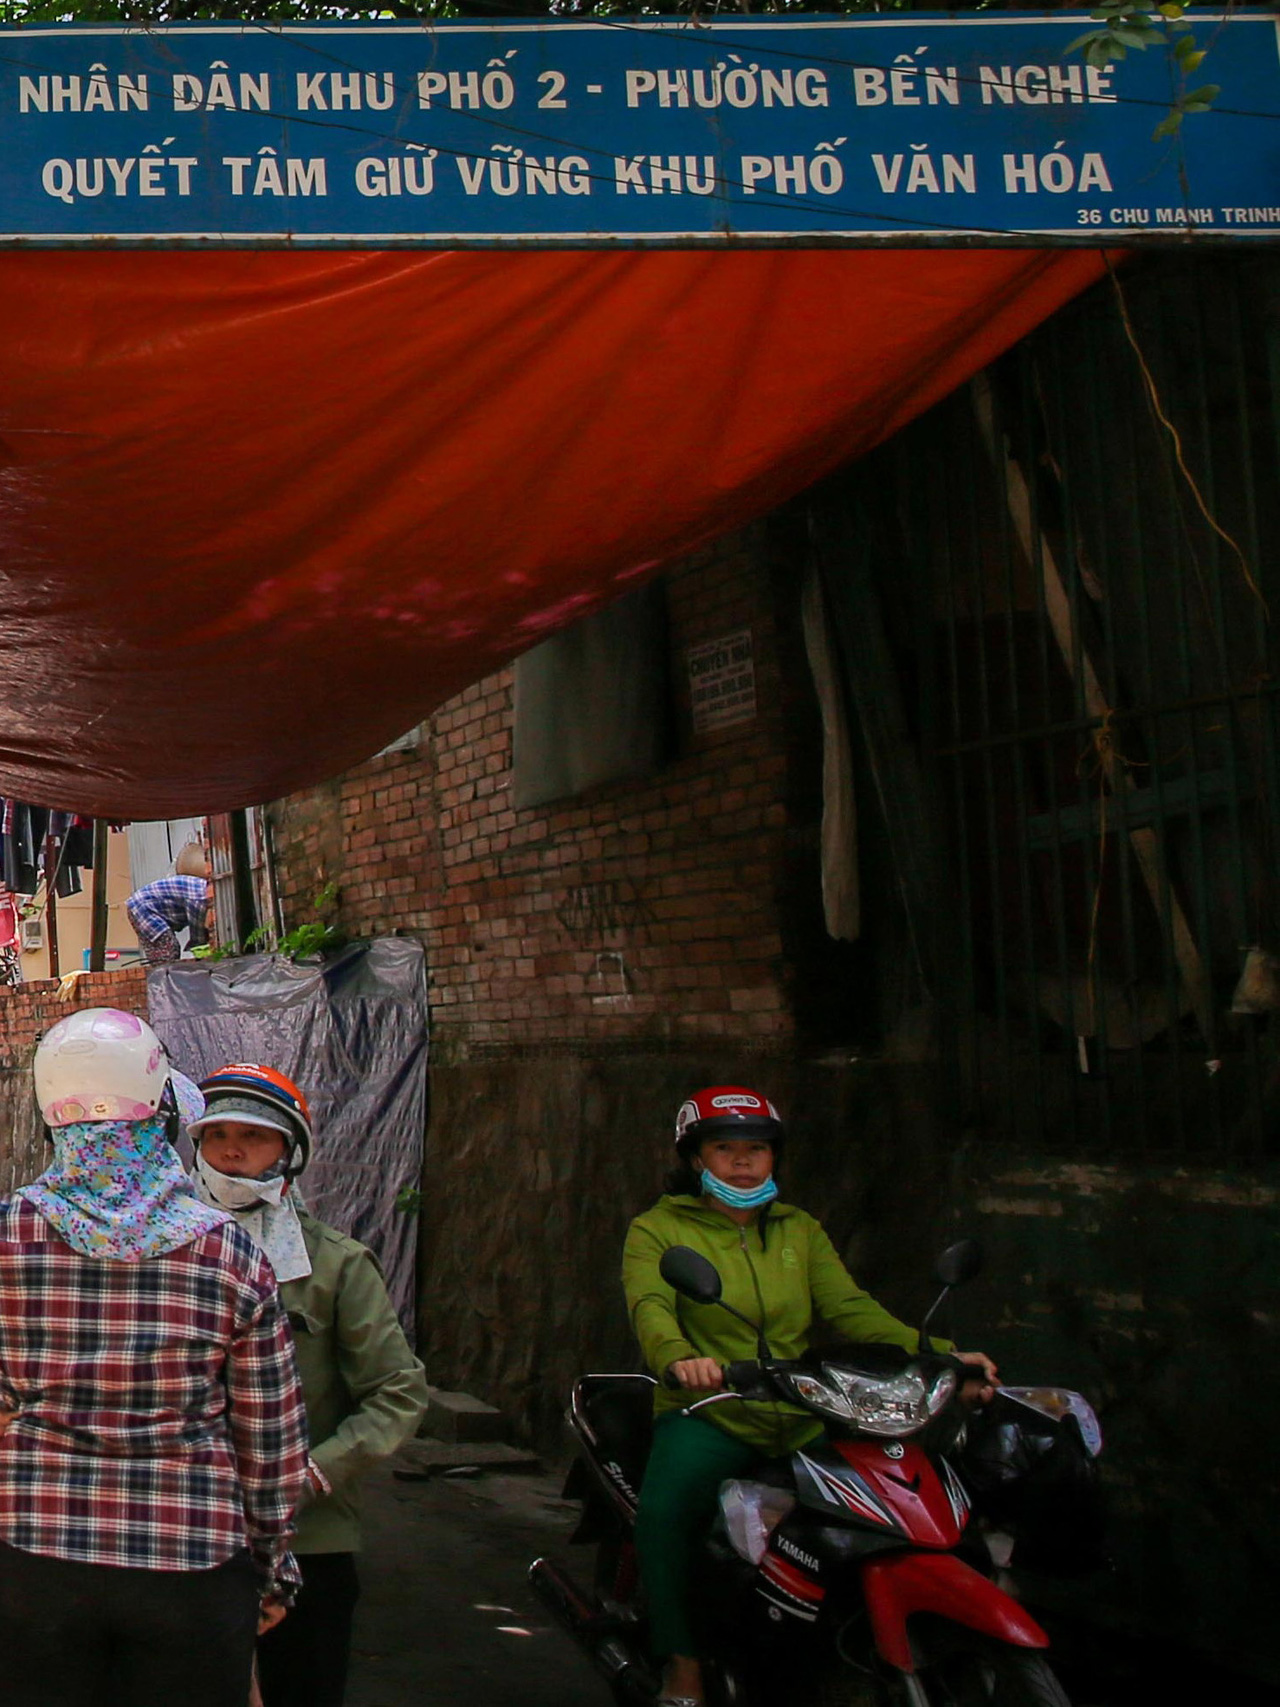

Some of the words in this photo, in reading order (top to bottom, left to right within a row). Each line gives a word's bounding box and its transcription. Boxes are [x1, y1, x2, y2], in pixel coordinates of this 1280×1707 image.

[20, 63, 148, 113] NHÂN
[173, 61, 270, 112] DÂN
[297, 72, 394, 111] KHU
[418, 50, 517, 110] PHỐ
[538, 71, 566, 109] 2
[626, 55, 828, 108] PHƯỜNG
[854, 47, 960, 106] BẾN
[42, 137, 198, 204] QUYẾT
[223, 147, 326, 196] TÂM
[355, 143, 438, 196] GIỮ
[456, 144, 590, 196] VỮNG
[615, 155, 715, 195] KHU
[742, 137, 846, 195] PHỐ
[872, 143, 976, 194] VĂN
[1004, 141, 1113, 194] HÓA
[1077, 209, 1102, 224] 36
[1110, 208, 1149, 223] CHU
[776, 1534, 819, 1572] YAMAHA
